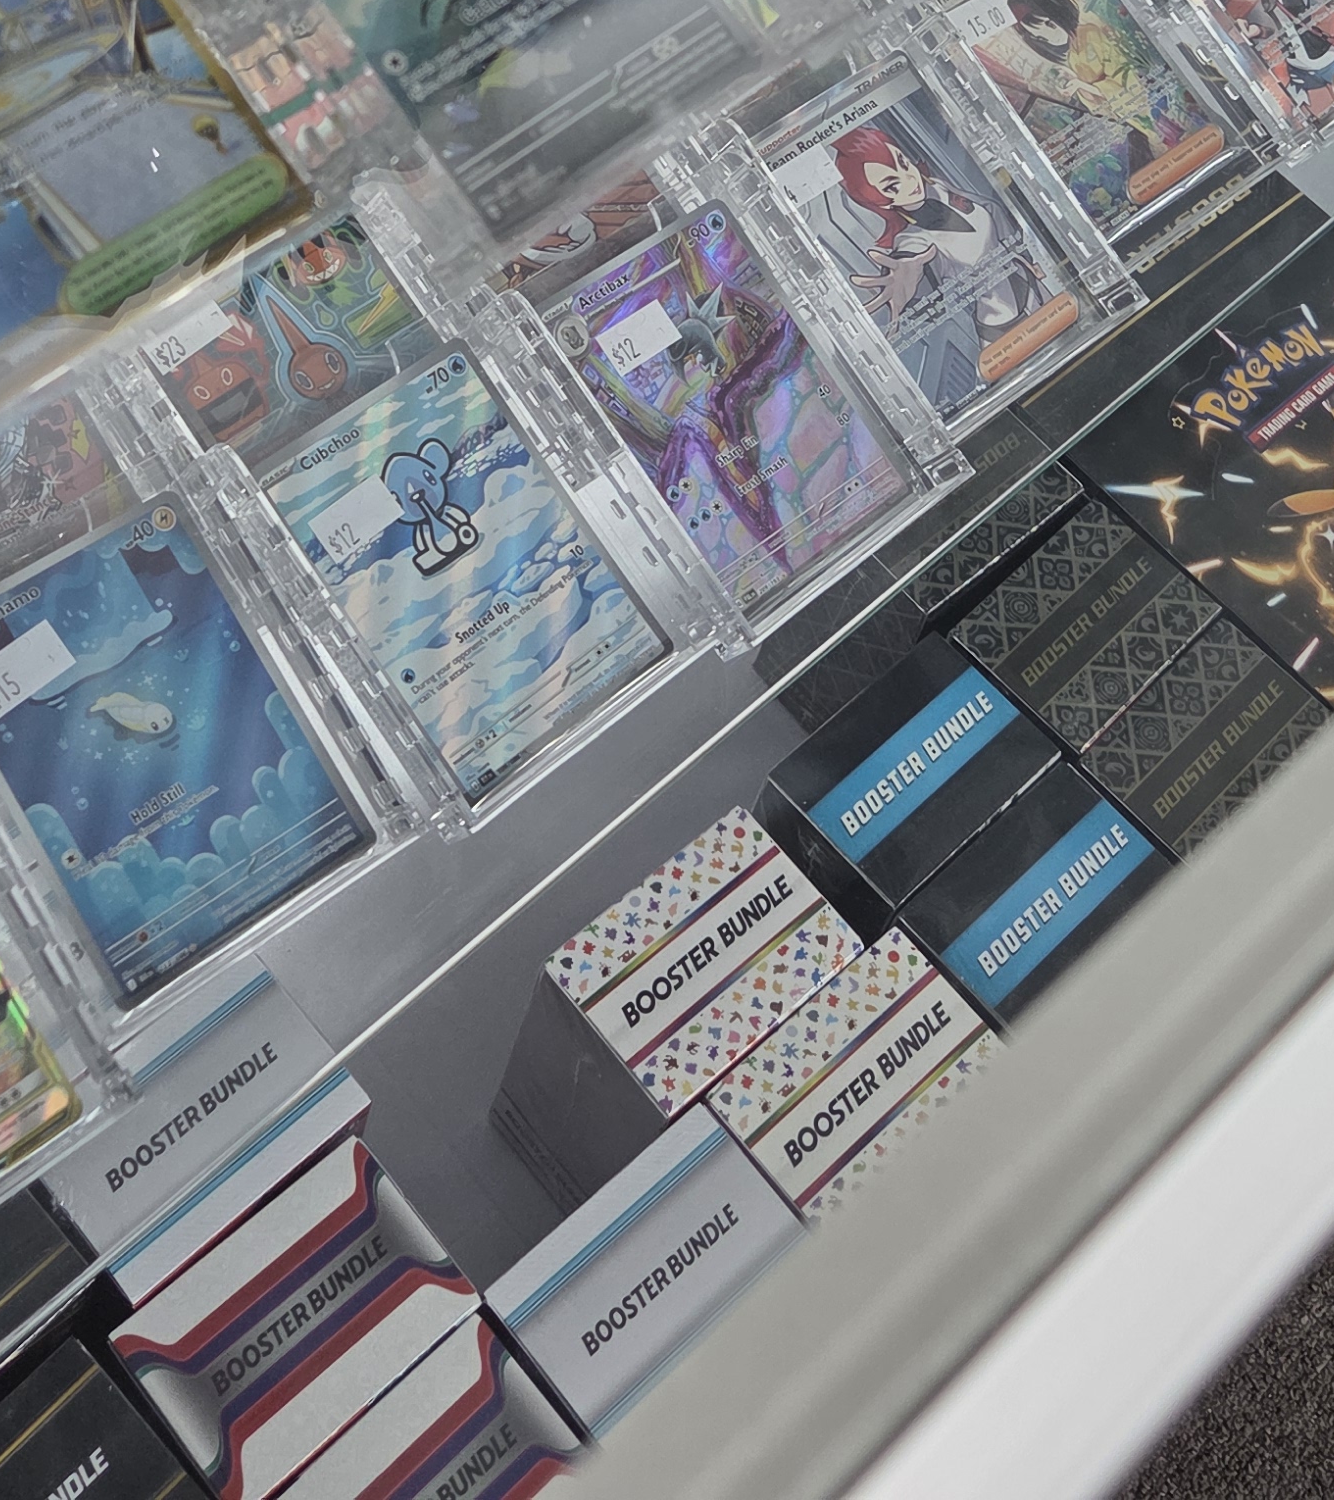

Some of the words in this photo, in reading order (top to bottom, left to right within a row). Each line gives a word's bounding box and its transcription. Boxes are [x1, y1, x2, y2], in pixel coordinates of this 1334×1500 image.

[966, 7, 1008, 40] 15.00
[853, 59, 905, 94] TRAINER
[795, 117, 844, 156] Rocket's
[841, 98, 880, 129] Ariana
[692, 222, 711, 244] 90
[576, 272, 632, 311] Arctibax
[155, 335, 187, 369] $23
[609, 337, 644, 367] $12
[431, 366, 452, 390] 70
[816, 383, 832, 400] 40
[835, 410, 851, 428] 80
[1255, 407, 1295, 443] TRADING
[1291, 390, 1317, 417] CARD
[298, 426, 362, 472] Cubchoo
[714, 440, 744, 469] Sharp
[741, 433, 759, 454] Fin
[734, 470, 763, 500] Frost
[759, 455, 790, 483] Smash
[132, 519, 156, 547] 40
[327, 522, 362, 558] $12
[569, 543, 585, 561] 10
[453, 610, 492, 646] Snotted
[489, 600, 512, 623] Up
[1020, 615, 1097, 690] BOOSTER
[1089, 555, 1155, 624] BUNDLE
[410, 675, 437, 697] During
[839, 749, 927, 838] BOOSTER
[922, 689, 994, 763] BUNDLE
[1151, 738, 1228, 821] BOOSTER
[1221, 676, 1286, 749] BUNDLE
[128, 795, 159, 828] Hold
[155, 781, 186, 811] Still
[976, 888, 1064, 978] BOOSTER
[1059, 823, 1130, 900] BUNDLE
[621, 926, 723, 1030] BOOSTER
[717, 873, 795, 948] BUNDLE
[782, 1055, 882, 1168] BOOSTER
[875, 1000, 953, 1077] BUNDLE
[105, 1101, 203, 1194] BOOSTER
[198, 1041, 280, 1114] BUNDLE
[580, 1270, 672, 1358] BOOSTER
[665, 1203, 741, 1280] BUNDLE
[209, 1301, 314, 1398] BOOSTER
[307, 1235, 390, 1316] BUNDLE
[433, 1422, 520, 1500] BUNDLE
